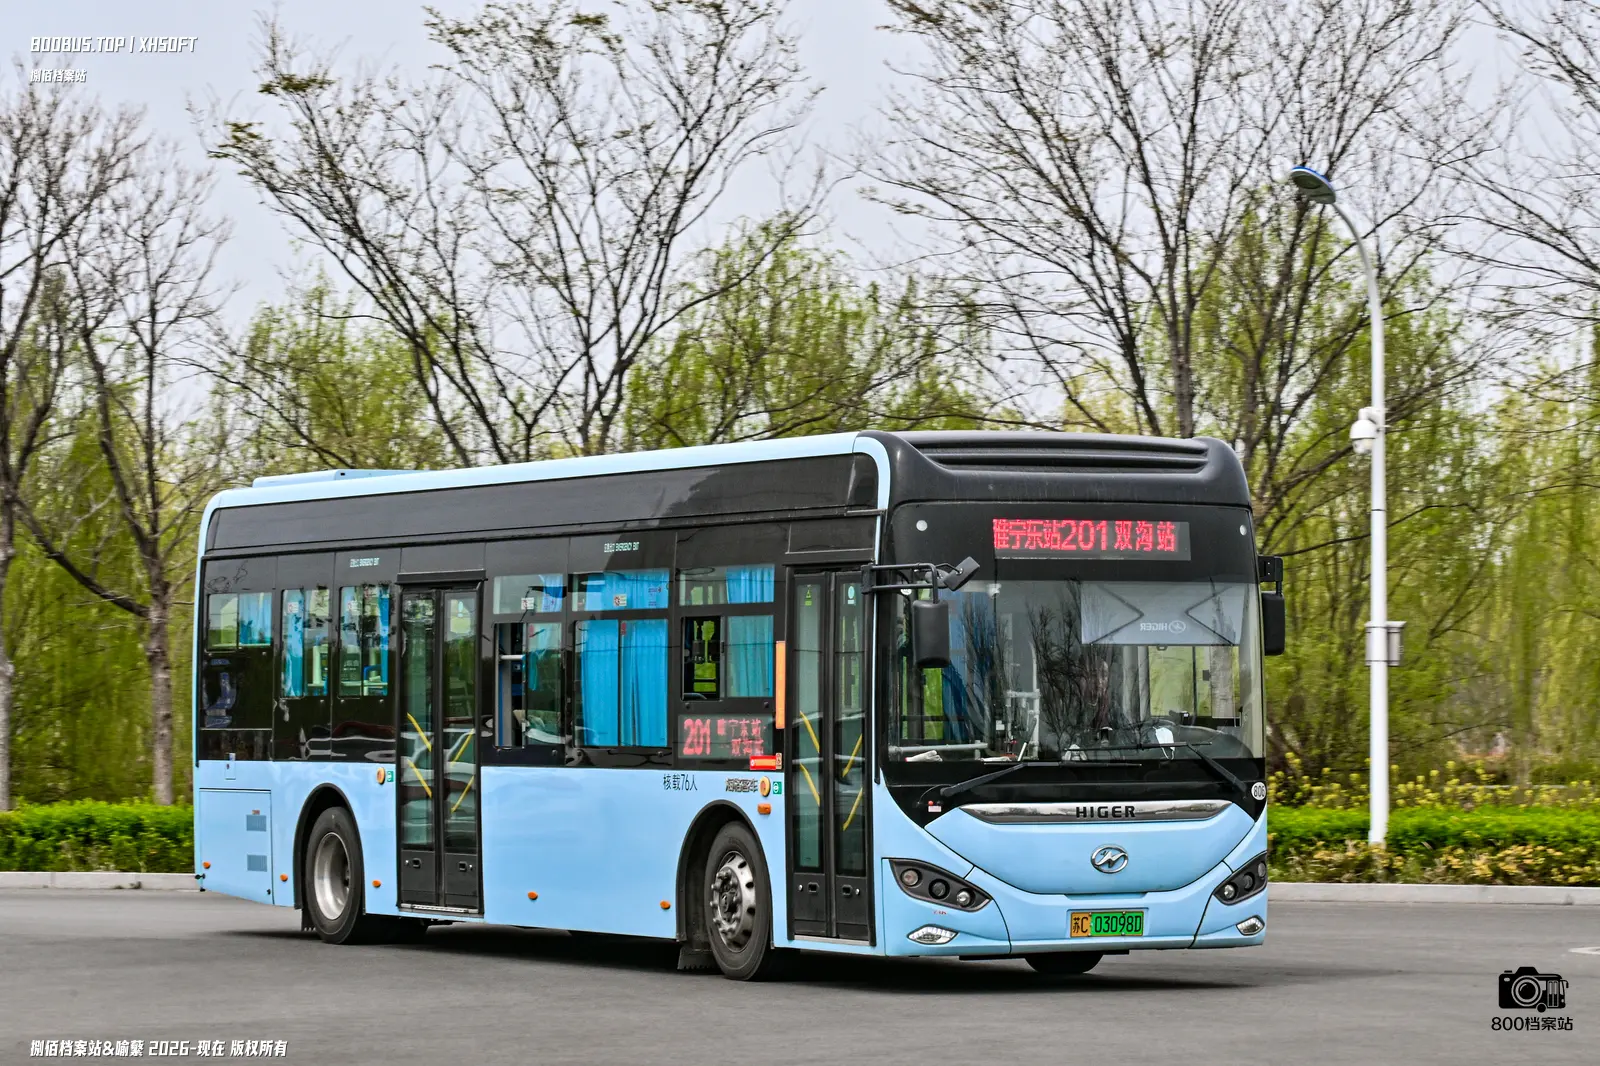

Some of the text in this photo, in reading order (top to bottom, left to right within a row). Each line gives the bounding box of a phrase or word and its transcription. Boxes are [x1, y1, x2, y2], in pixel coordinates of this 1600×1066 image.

[683, 718, 711, 755] 201
[663, 773, 698, 791] 核载76人
[1075, 805, 1136, 818] HIGER
